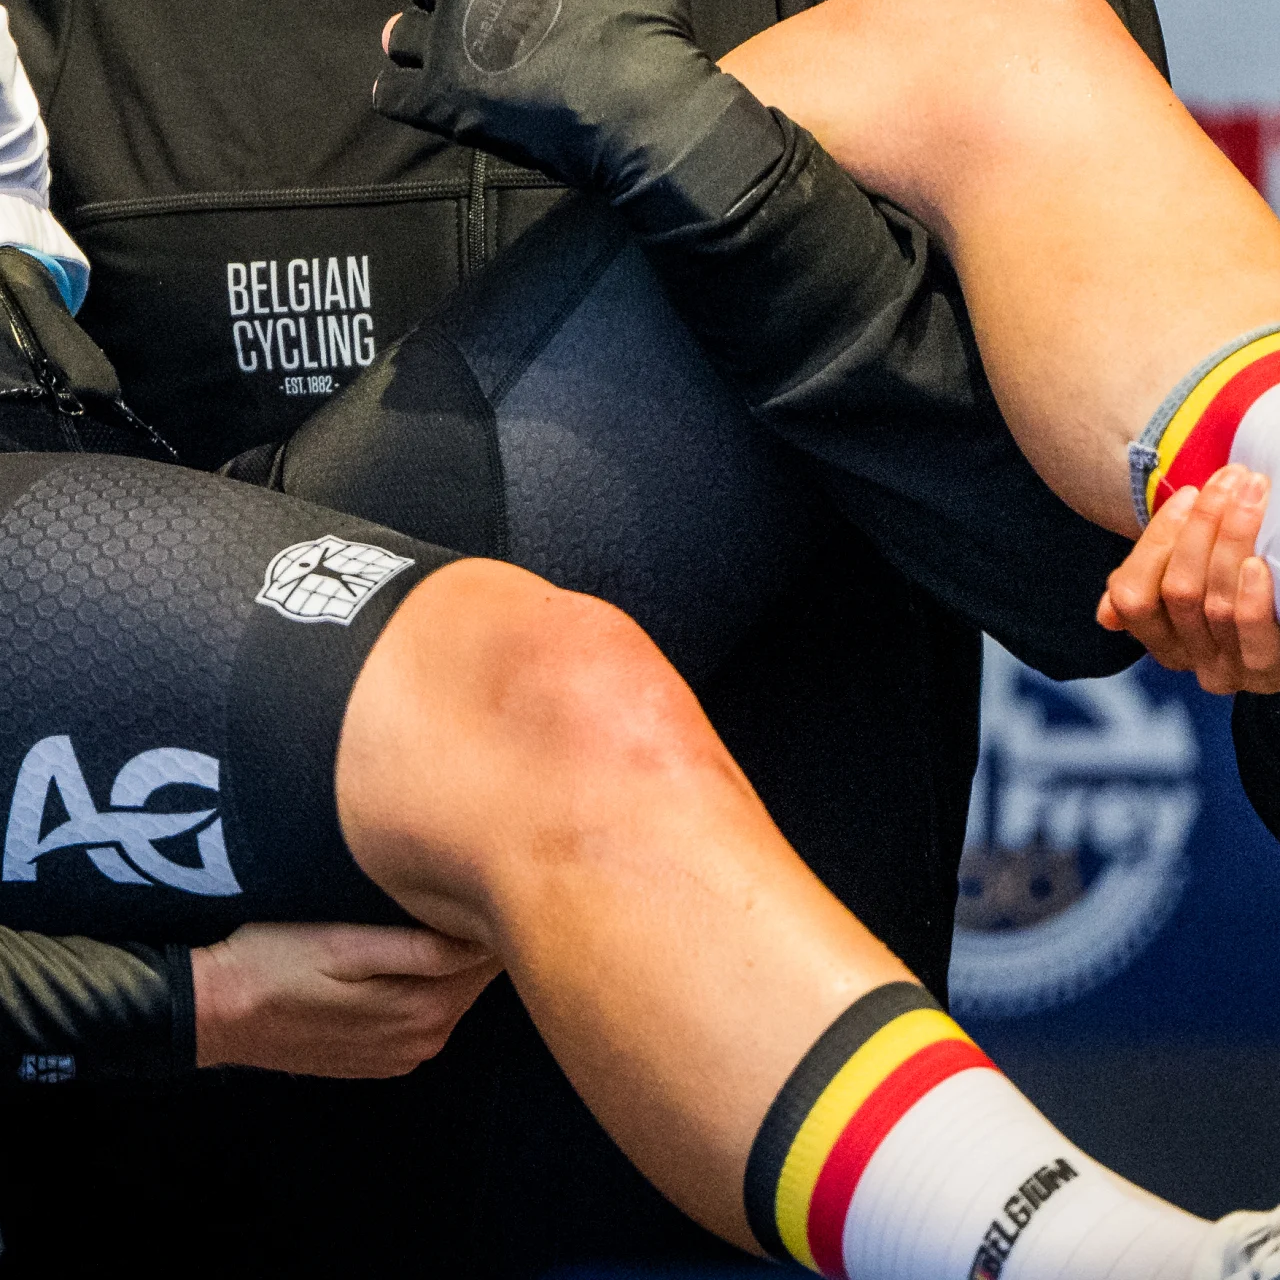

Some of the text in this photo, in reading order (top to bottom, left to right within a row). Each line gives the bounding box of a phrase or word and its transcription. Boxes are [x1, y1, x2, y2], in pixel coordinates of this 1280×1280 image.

[227, 255, 370, 316] BELGIAN
[233, 313, 376, 372] CYCLING
[1, 734, 244, 897] AG
